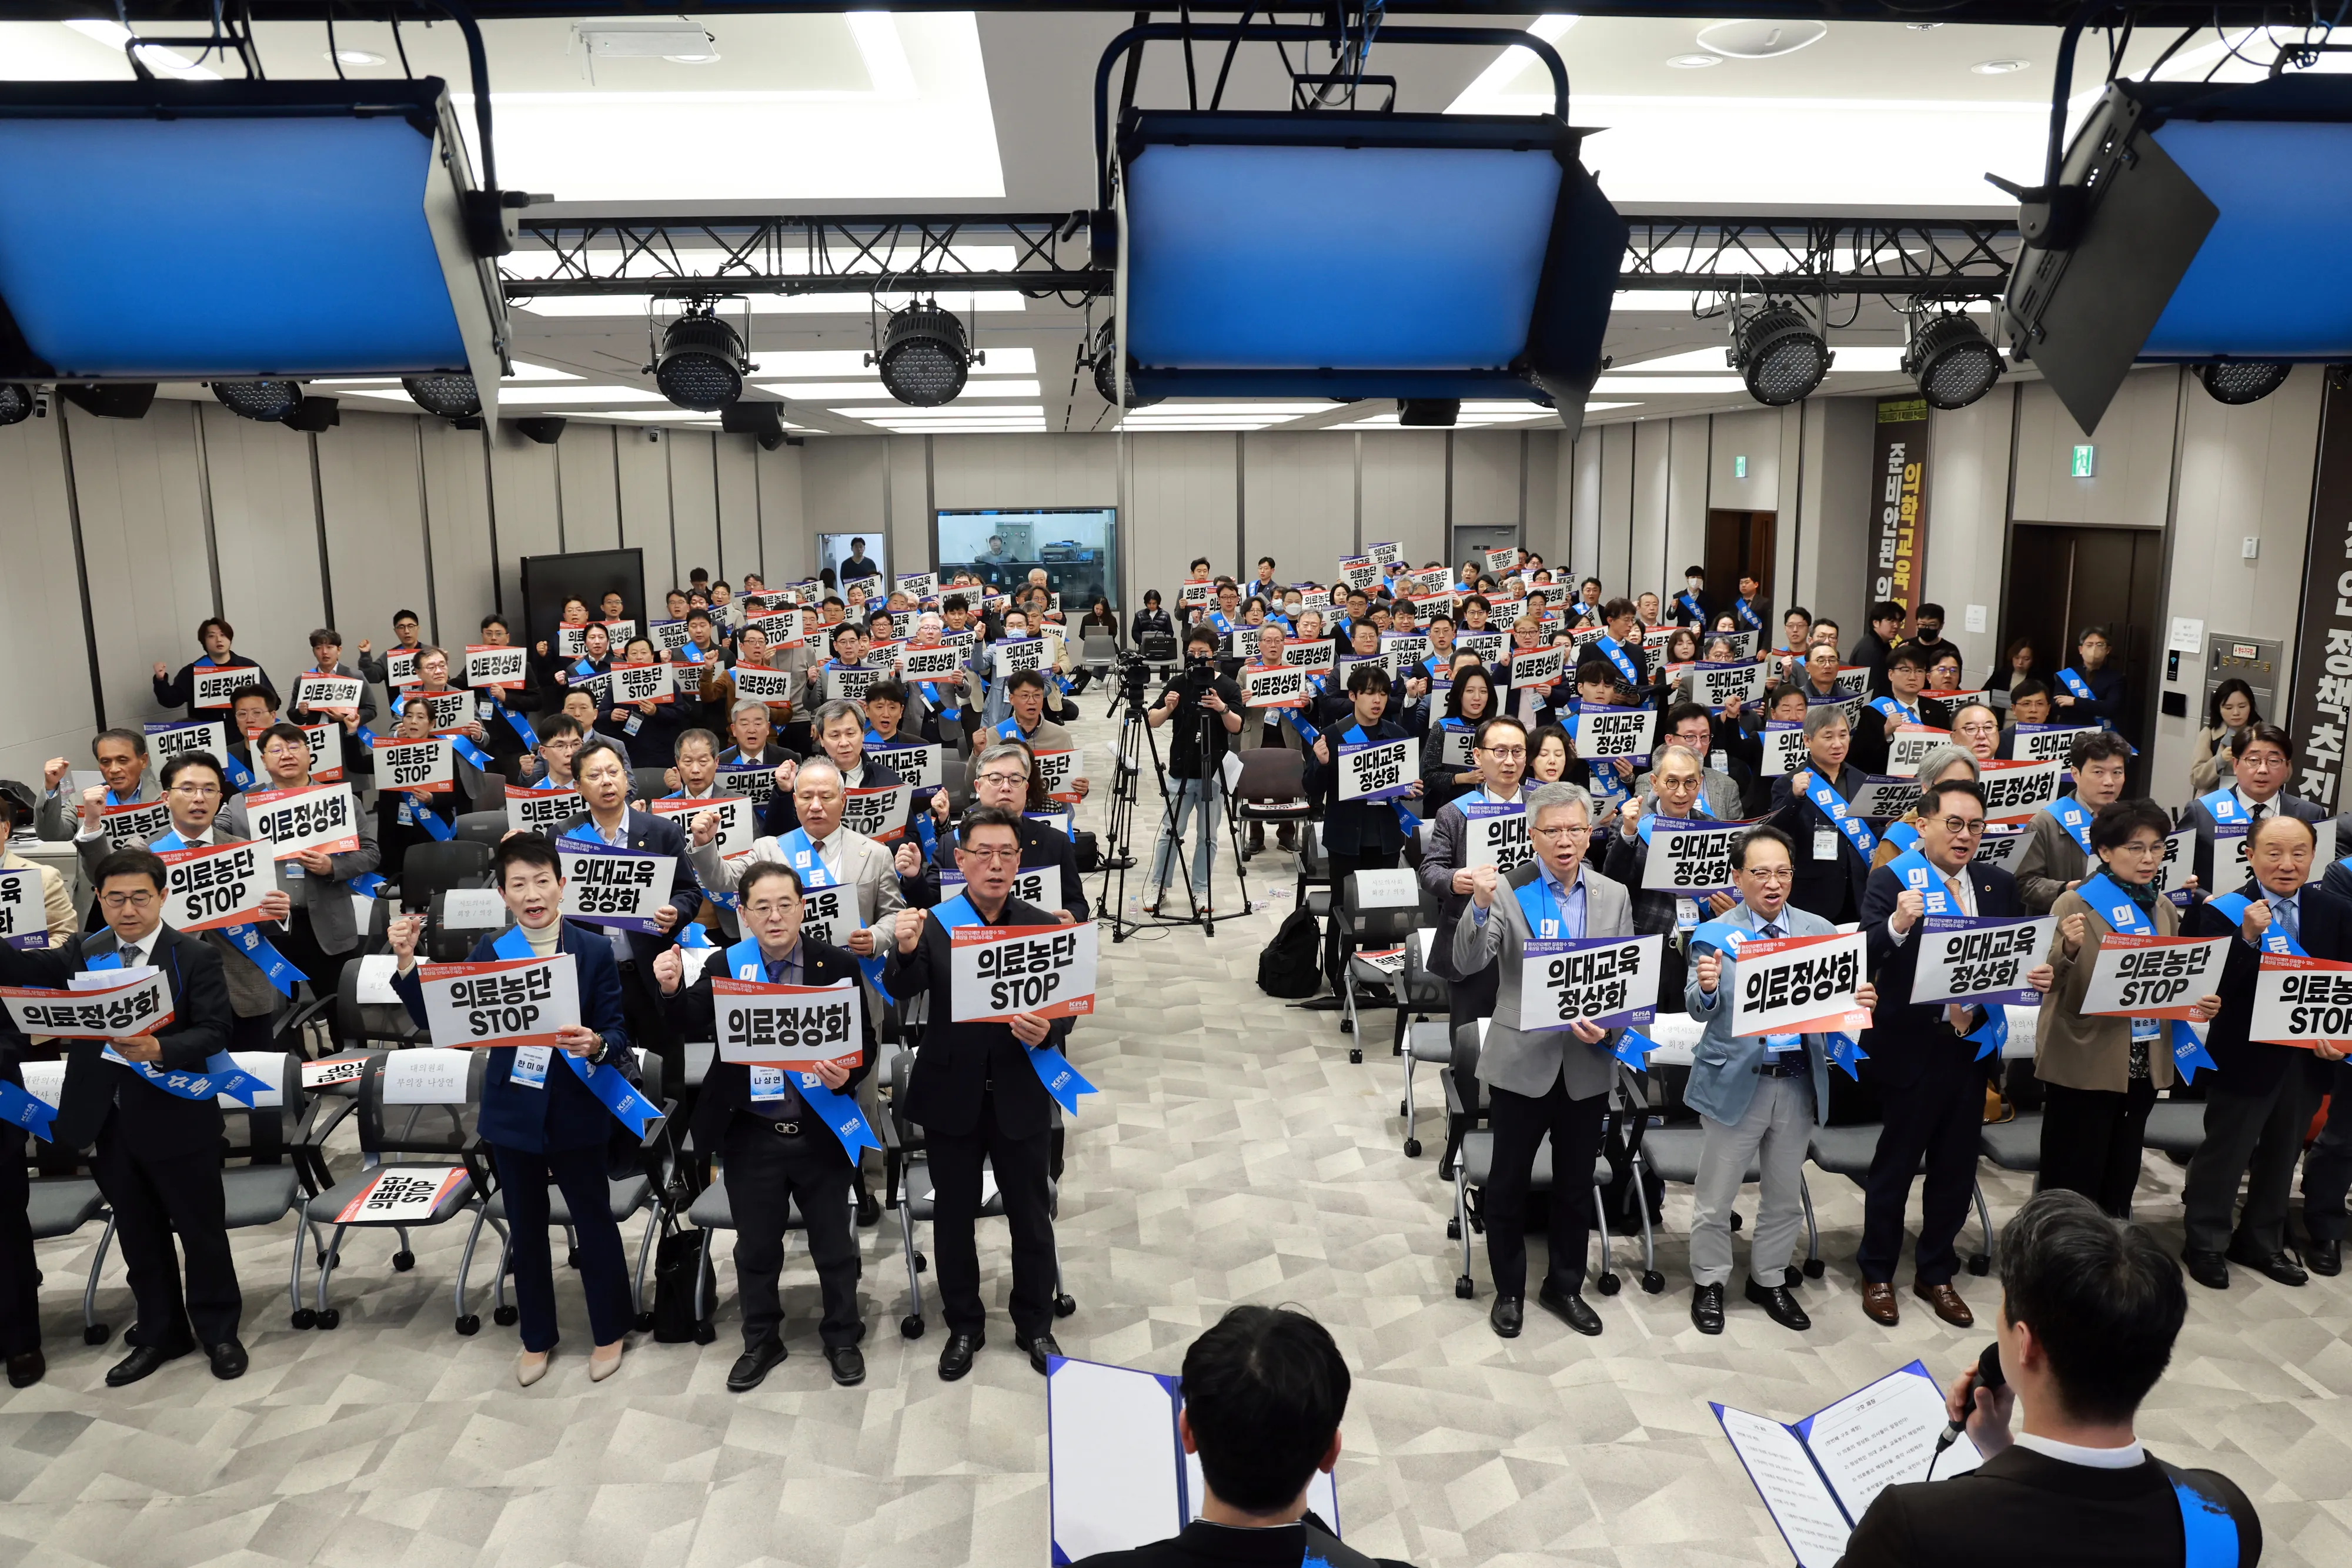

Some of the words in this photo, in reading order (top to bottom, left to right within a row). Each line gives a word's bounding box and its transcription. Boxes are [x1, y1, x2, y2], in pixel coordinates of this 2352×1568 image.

[1893, 462, 1922, 591] 의학교육
[1374, 544, 1396, 557] 의대교육
[1377, 554, 1395, 564] 정상화
[1491, 550, 1513, 562] 의료농단
[1350, 566, 1377, 579] 의료농단
[1495, 560, 1511, 569] STOP
[904, 576, 931, 589] 의대교육
[1354, 577, 1373, 589] STOP
[1421, 570, 1447, 583] 의료농단
[1488, 603, 1519, 619] 의료농단
[757, 613, 793, 632] 의료농단
[664, 636, 687, 648] 정상화
[1006, 641, 1043, 659] 의대교육
[1390, 638, 1427, 653] 의대교육
[1466, 636, 1502, 648] 의대교육
[471, 654, 522, 677] 의료정상화
[907, 650, 956, 673] 의료정상화
[1011, 656, 1039, 672] 정상화
[1286, 646, 1331, 665] 의료정상화
[1515, 652, 1561, 680] 의료정상화
[622, 667, 662, 685] 의료농단
[739, 674, 787, 696] 의료정상화
[839, 671, 880, 685] 의대교육
[1251, 673, 1301, 697] 의료정상화
[1706, 668, 1756, 688] 의대교육
[302, 680, 357, 702] 의료정상화
[629, 683, 657, 698] STOP
[1591, 714, 1645, 735] 의대교육
[158, 727, 212, 754] 의대교육
[1596, 735, 1636, 755] 정상화
[386, 743, 439, 767] 의료농단
[873, 748, 928, 774] 의대교육
[1353, 744, 1406, 773] 의대교육
[395, 765, 431, 784] STOP
[1359, 765, 1399, 792] 정상화
[259, 794, 347, 845] 의료정상화
[171, 848, 255, 895] 의료농단
[572, 858, 656, 888] 의대교육
[1674, 859, 1732, 887] 정상화
[186, 884, 246, 921] STOP
[579, 887, 640, 914] 정상화
[977, 932, 1076, 979] 의료농단
[1943, 925, 2036, 965] 의대교육
[1546, 945, 1641, 988] 의대교육
[2115, 945, 2211, 979] 의료농단
[1743, 948, 1859, 1014] 의료정상화
[1949, 958, 2019, 994] 정상화
[450, 966, 552, 1009] 의료농단
[990, 972, 1060, 1011] STOP
[2119, 978, 2189, 1007] STOP
[2280, 975, 2352, 1005] 의료농
[23, 985, 160, 1030] 의료정상화
[1558, 979, 1628, 1020] 정상화
[469, 1004, 539, 1036] STOP
[729, 1002, 851, 1047] 의료정상화
[1617, 1034, 1630, 1053] KMA
[2176, 1042, 2195, 1056] KMA
[410, 1064, 445, 1073] 대의원회
[837, 1057, 857, 1065] KMA
[396, 1077, 422, 1088] 부의장
[428, 1077, 454, 1088] 나상연
[1051, 1070, 1068, 1088] KMA
[617, 1094, 633, 1112] KMA
[367, 1176, 413, 1210] 의료농단
[401, 1180, 438, 1204] STOP
